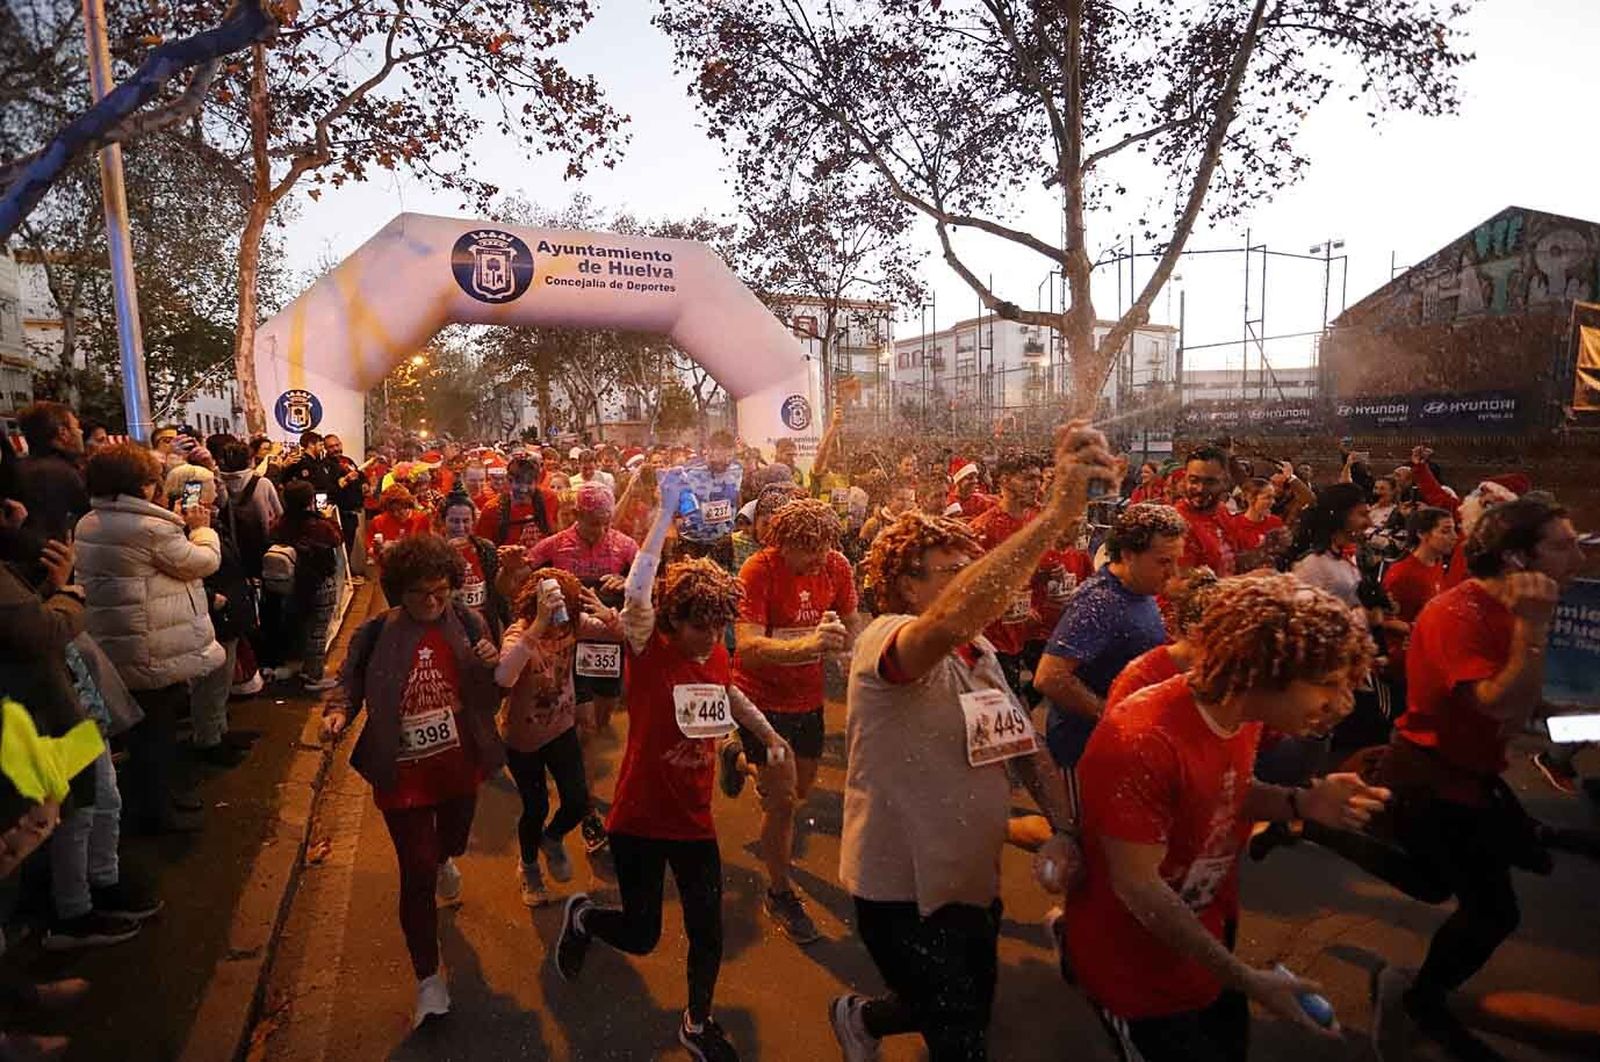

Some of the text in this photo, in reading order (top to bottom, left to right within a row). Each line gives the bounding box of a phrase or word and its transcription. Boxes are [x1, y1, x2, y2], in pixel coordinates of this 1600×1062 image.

[537, 240, 672, 262] Ayuntamiento
[578, 259, 674, 279] de Huelva
[609, 280, 623, 290] de
[626, 280, 676, 292] Deportes
[1355, 404, 1409, 415] HYUNDAI
[1450, 399, 1516, 412] HYUNDAI
[594, 653, 616, 669] 353
[698, 700, 726, 721] 448
[993, 708, 1026, 738] 449
[415, 722, 451, 746] 398
